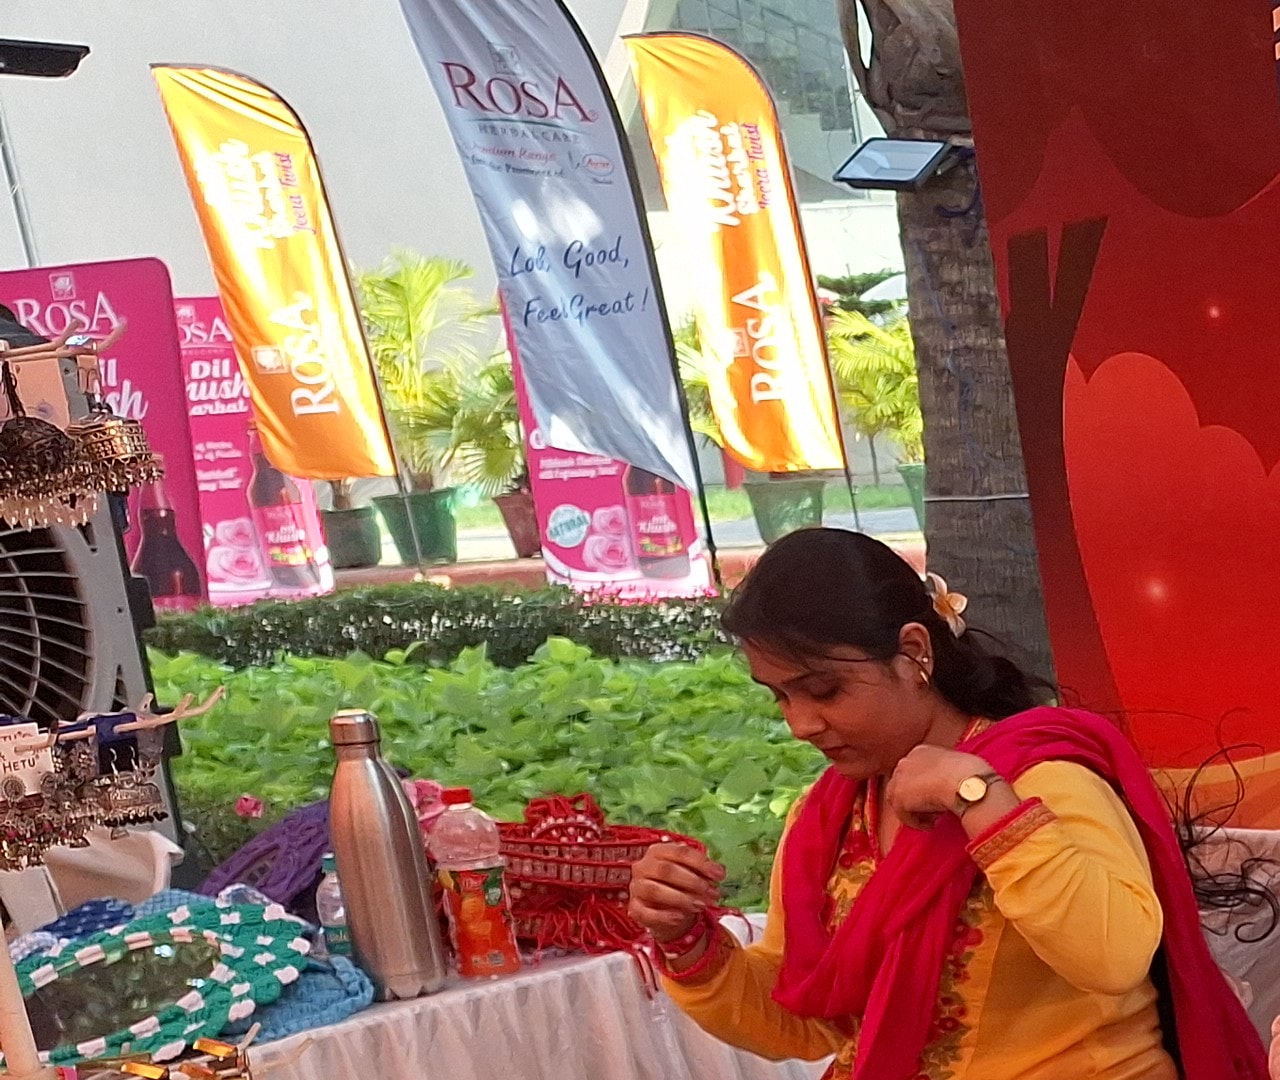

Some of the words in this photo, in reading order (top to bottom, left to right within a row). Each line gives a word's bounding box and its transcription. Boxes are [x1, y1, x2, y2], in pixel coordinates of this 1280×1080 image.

[563, 235, 630, 279] Good,
[13, 290, 122, 337] ROSA
[269, 291, 340, 416] ROSA
[732, 271, 785, 404] ROSA
[190, 357, 231, 380] Dil
[2, 757, 36, 774] HETU
